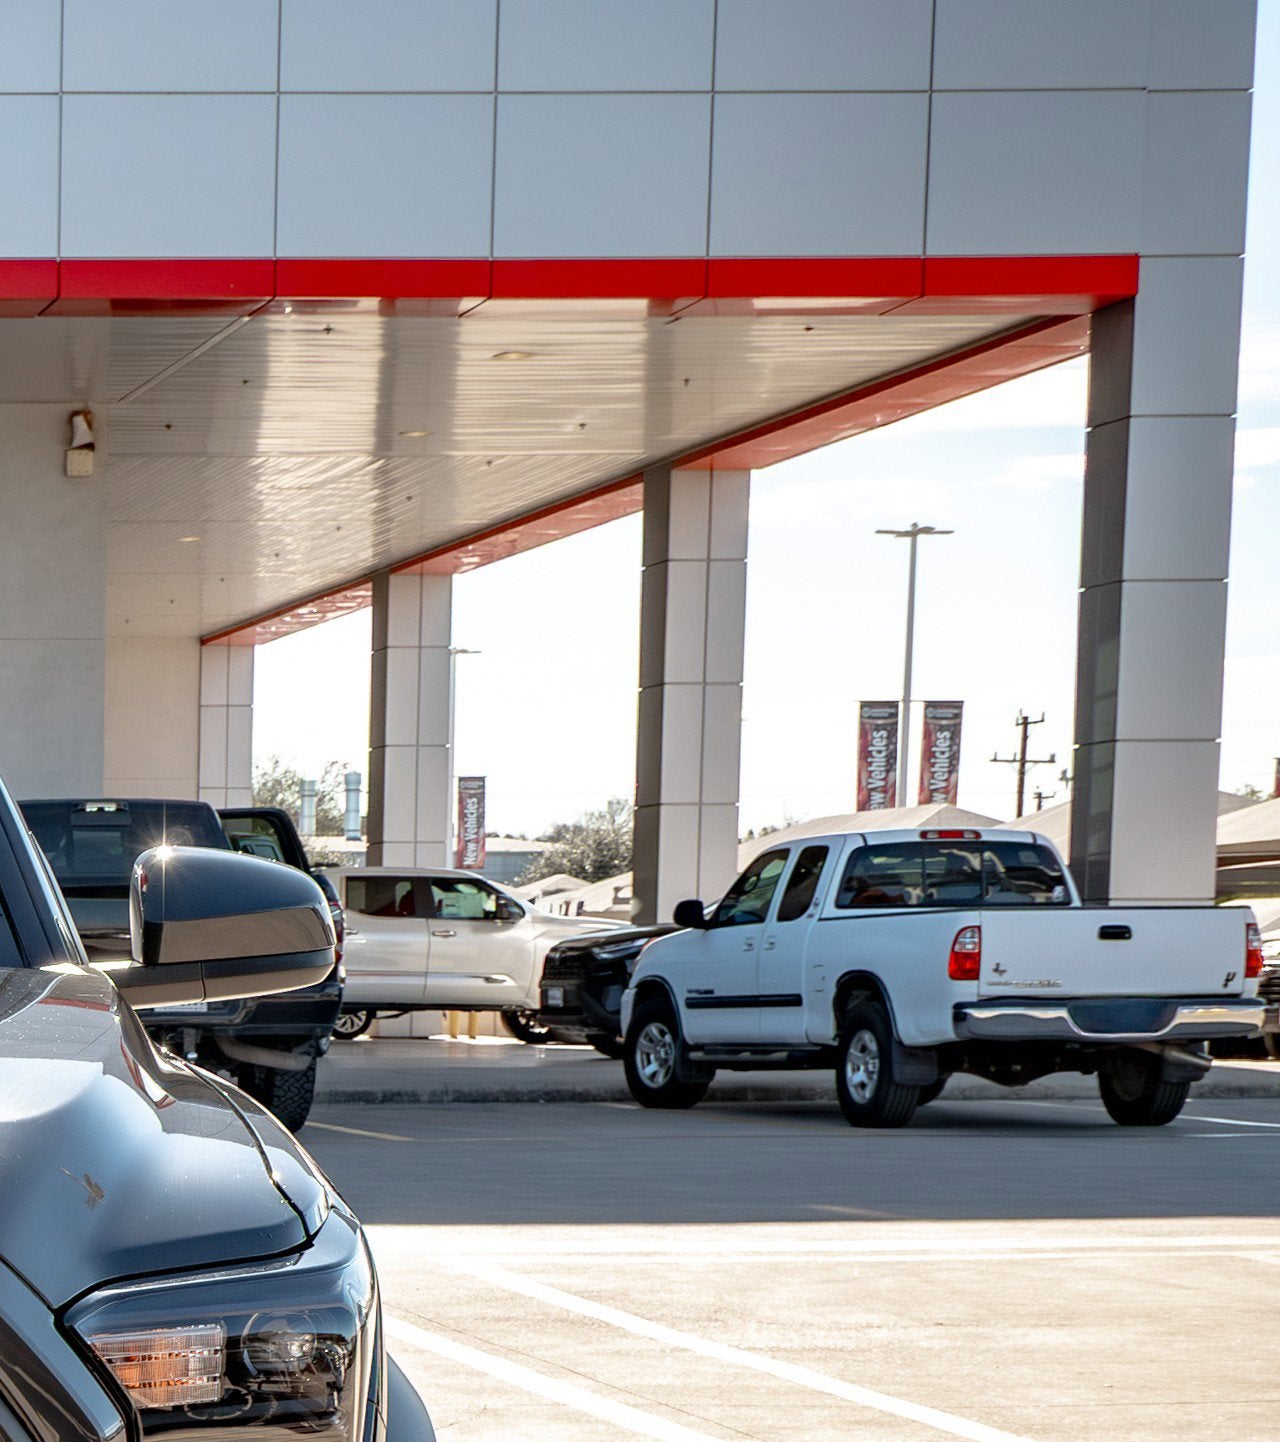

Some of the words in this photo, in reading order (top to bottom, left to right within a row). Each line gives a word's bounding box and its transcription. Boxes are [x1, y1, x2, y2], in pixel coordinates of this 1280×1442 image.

[866, 729, 889, 789] Vehicles
[928, 729, 952, 791] Vehicles
[463, 797, 479, 840] Vehicles
[463, 843, 478, 866] New
